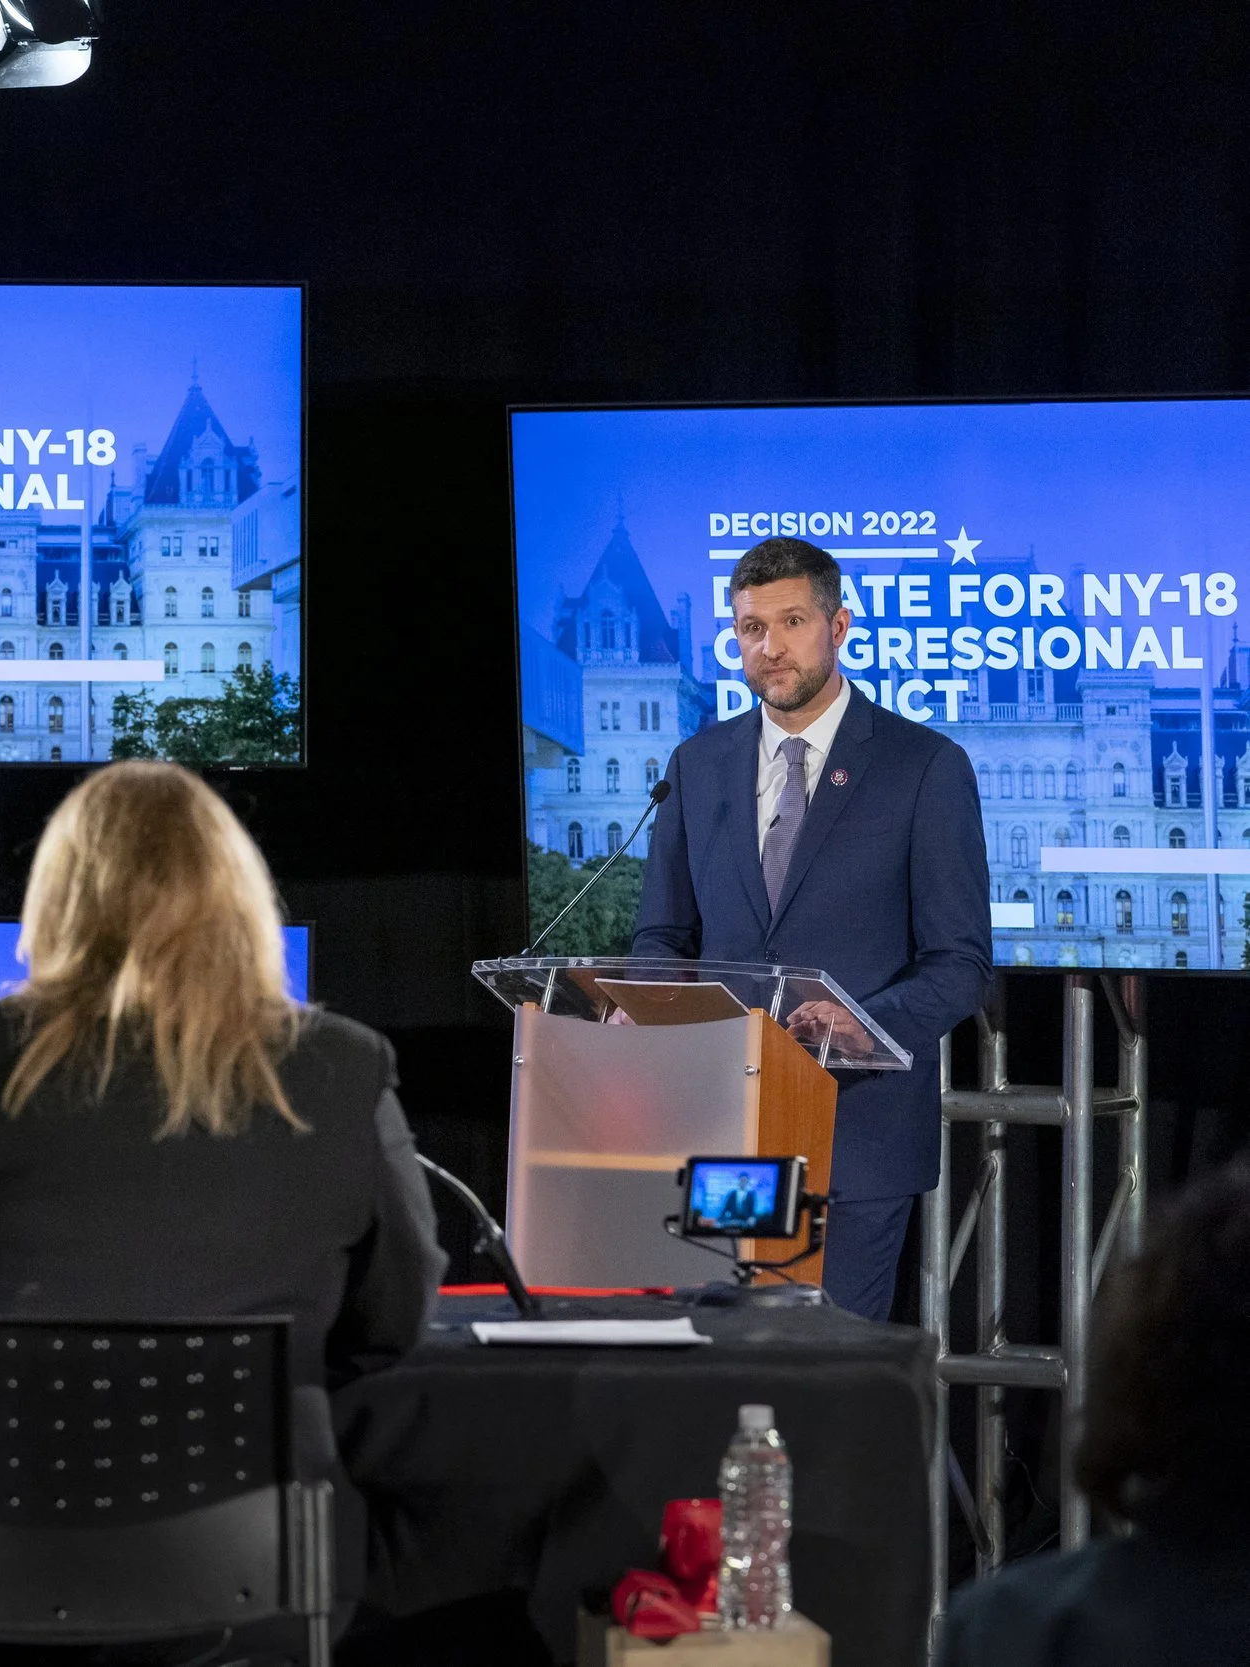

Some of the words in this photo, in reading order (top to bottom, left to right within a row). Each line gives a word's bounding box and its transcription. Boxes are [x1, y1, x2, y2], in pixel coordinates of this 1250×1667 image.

[709, 512, 853, 537] DECISION
[862, 511, 937, 535] 2022
[949, 574, 1066, 617] FOR
[1083, 572, 1239, 617] NY-18
[713, 626, 1204, 670] CGRESSIONAL
